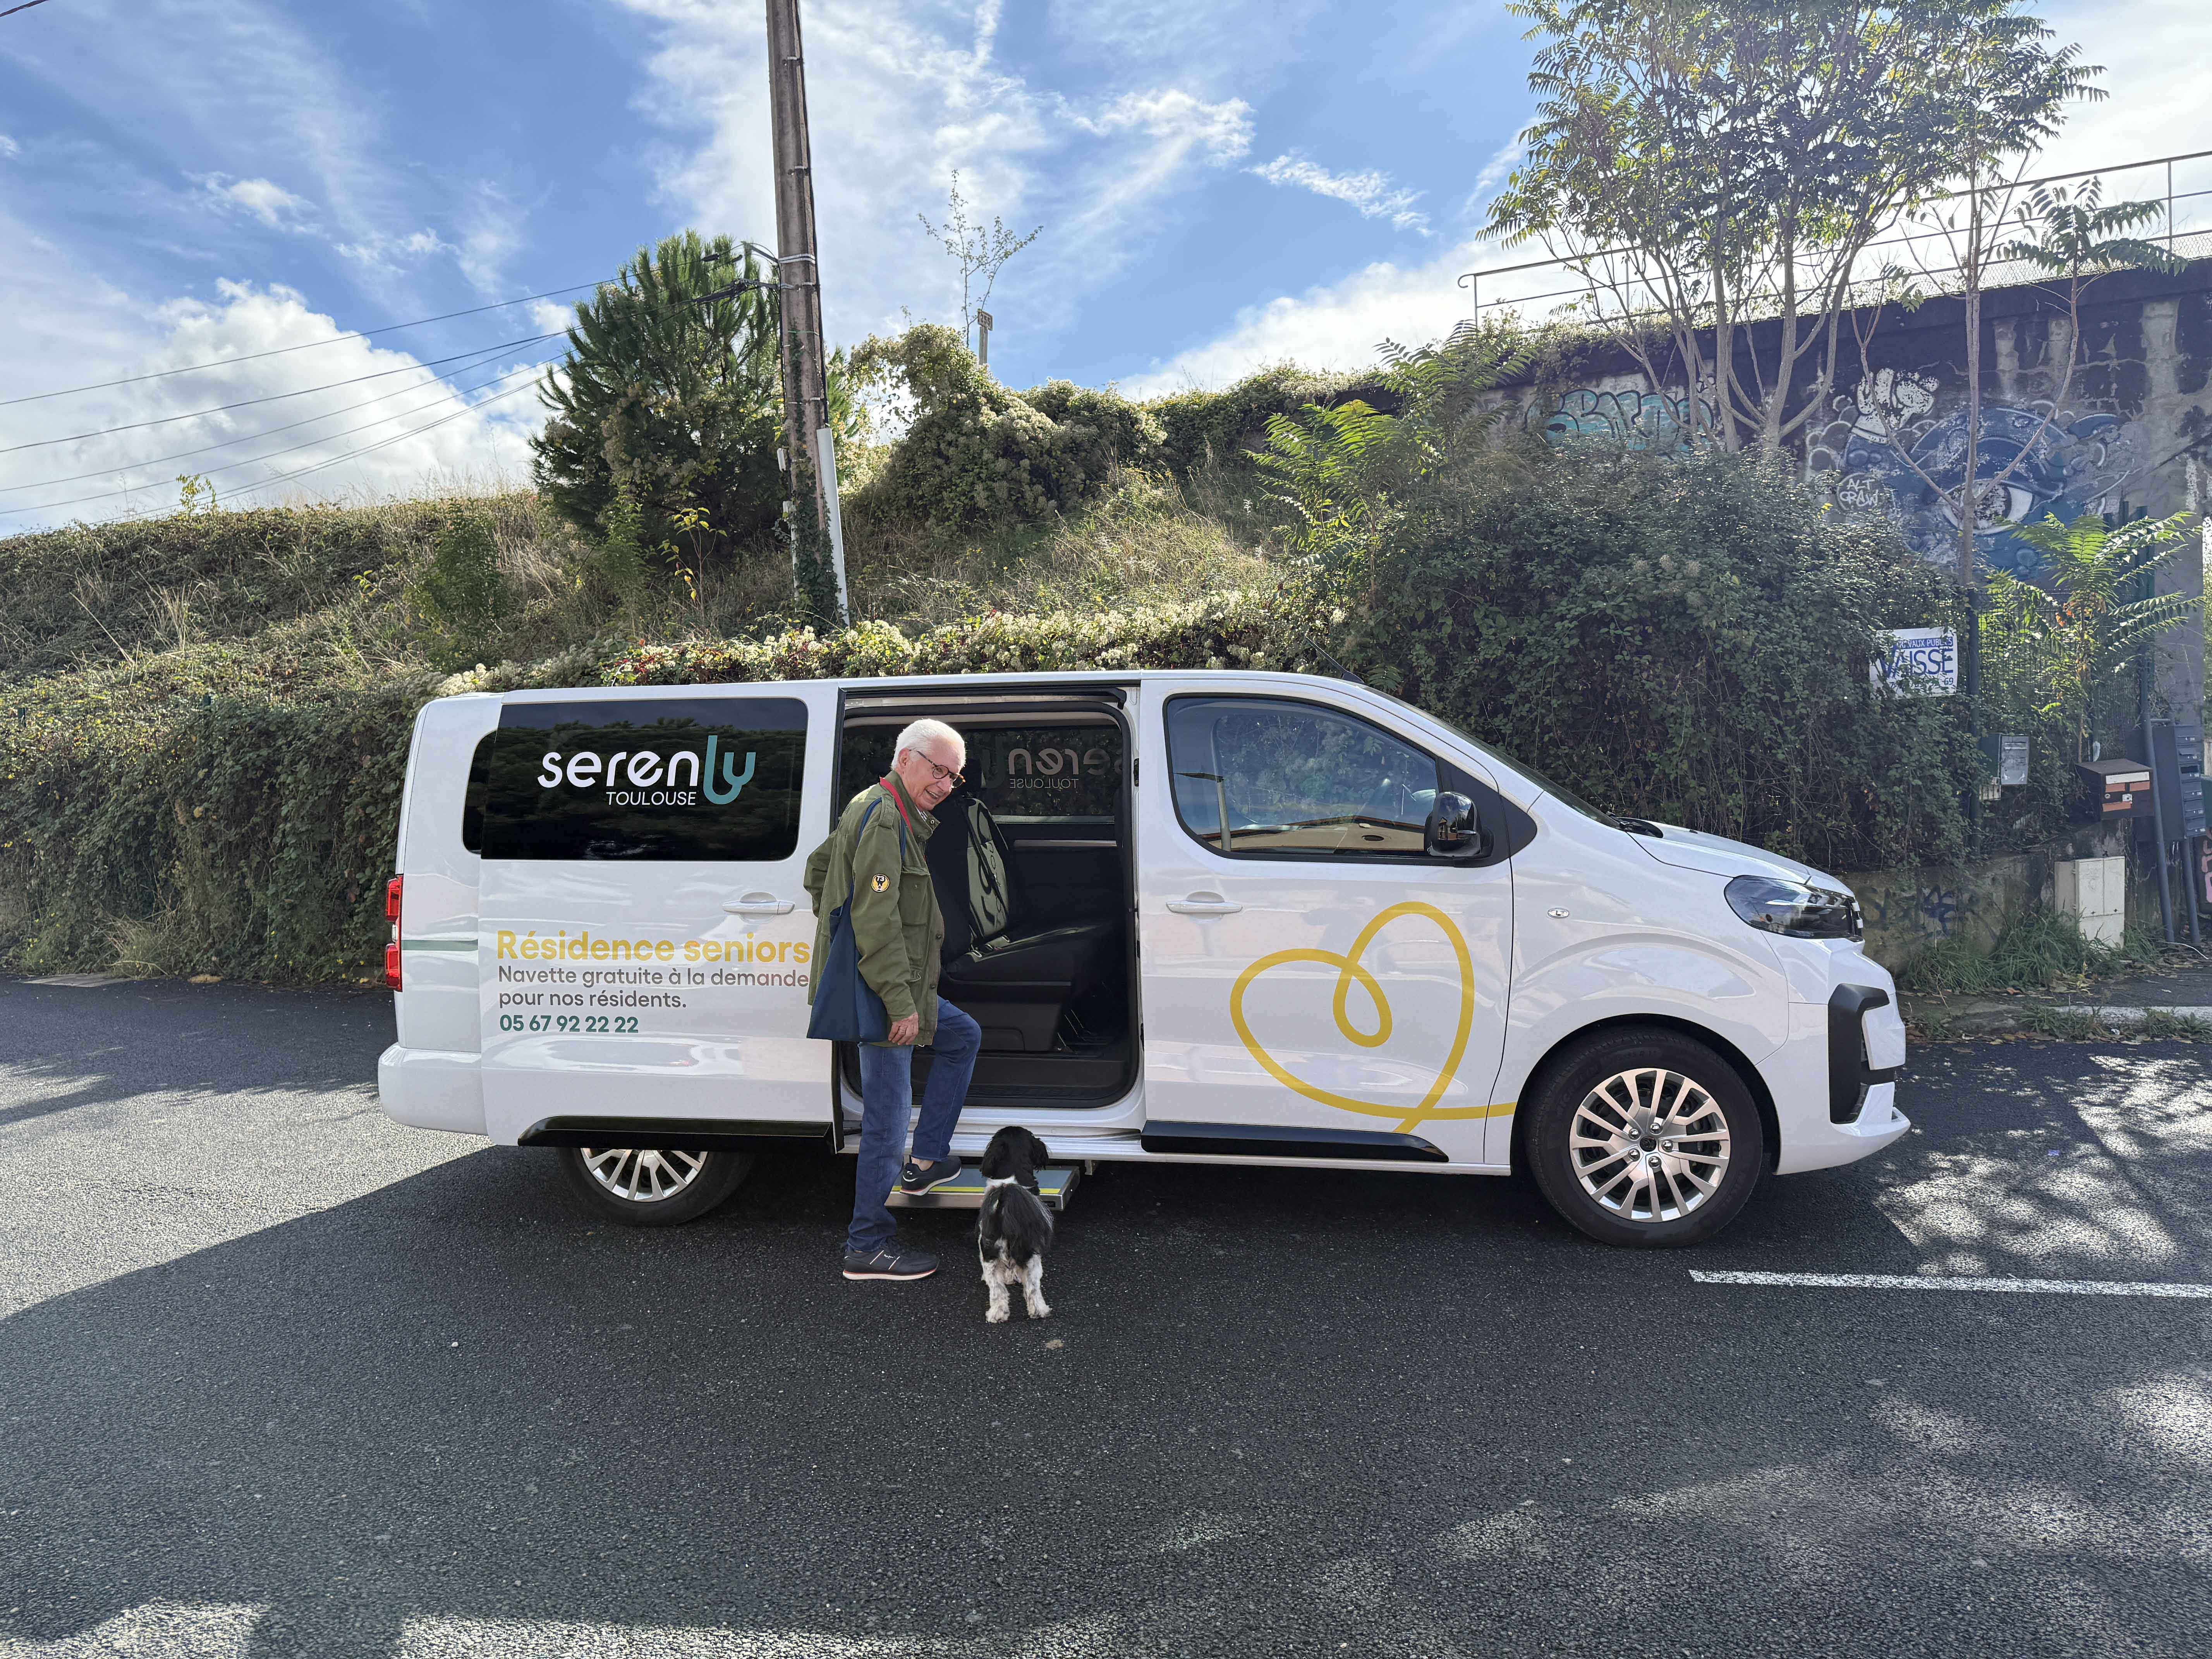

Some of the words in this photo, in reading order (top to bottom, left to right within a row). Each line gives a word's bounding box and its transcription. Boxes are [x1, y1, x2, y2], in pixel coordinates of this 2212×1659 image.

[1846, 478, 1875, 491] ALT
[1927, 637, 1953, 647] PUBLS
[538, 735, 756, 805] serenly
[606, 791, 697, 805] TOULOUSE
[497, 930, 675, 961] Résidence
[684, 932, 810, 963] seniors
[498, 965, 577, 983] Navette
[582, 967, 663, 988] gratuite
[668, 968, 681, 985] à
[687, 968, 704, 985] la
[711, 969, 809, 987] demande
[499, 992, 544, 1008] pour
[550, 993, 584, 1006] nos
[589, 989, 687, 1008] résidents.
[500, 1014, 524, 1031] 05
[529, 1015, 551, 1032] 67
[556, 1015, 580, 1032] 92
[585, 1016, 609, 1032] 22
[614, 1016, 639, 1033] 22
